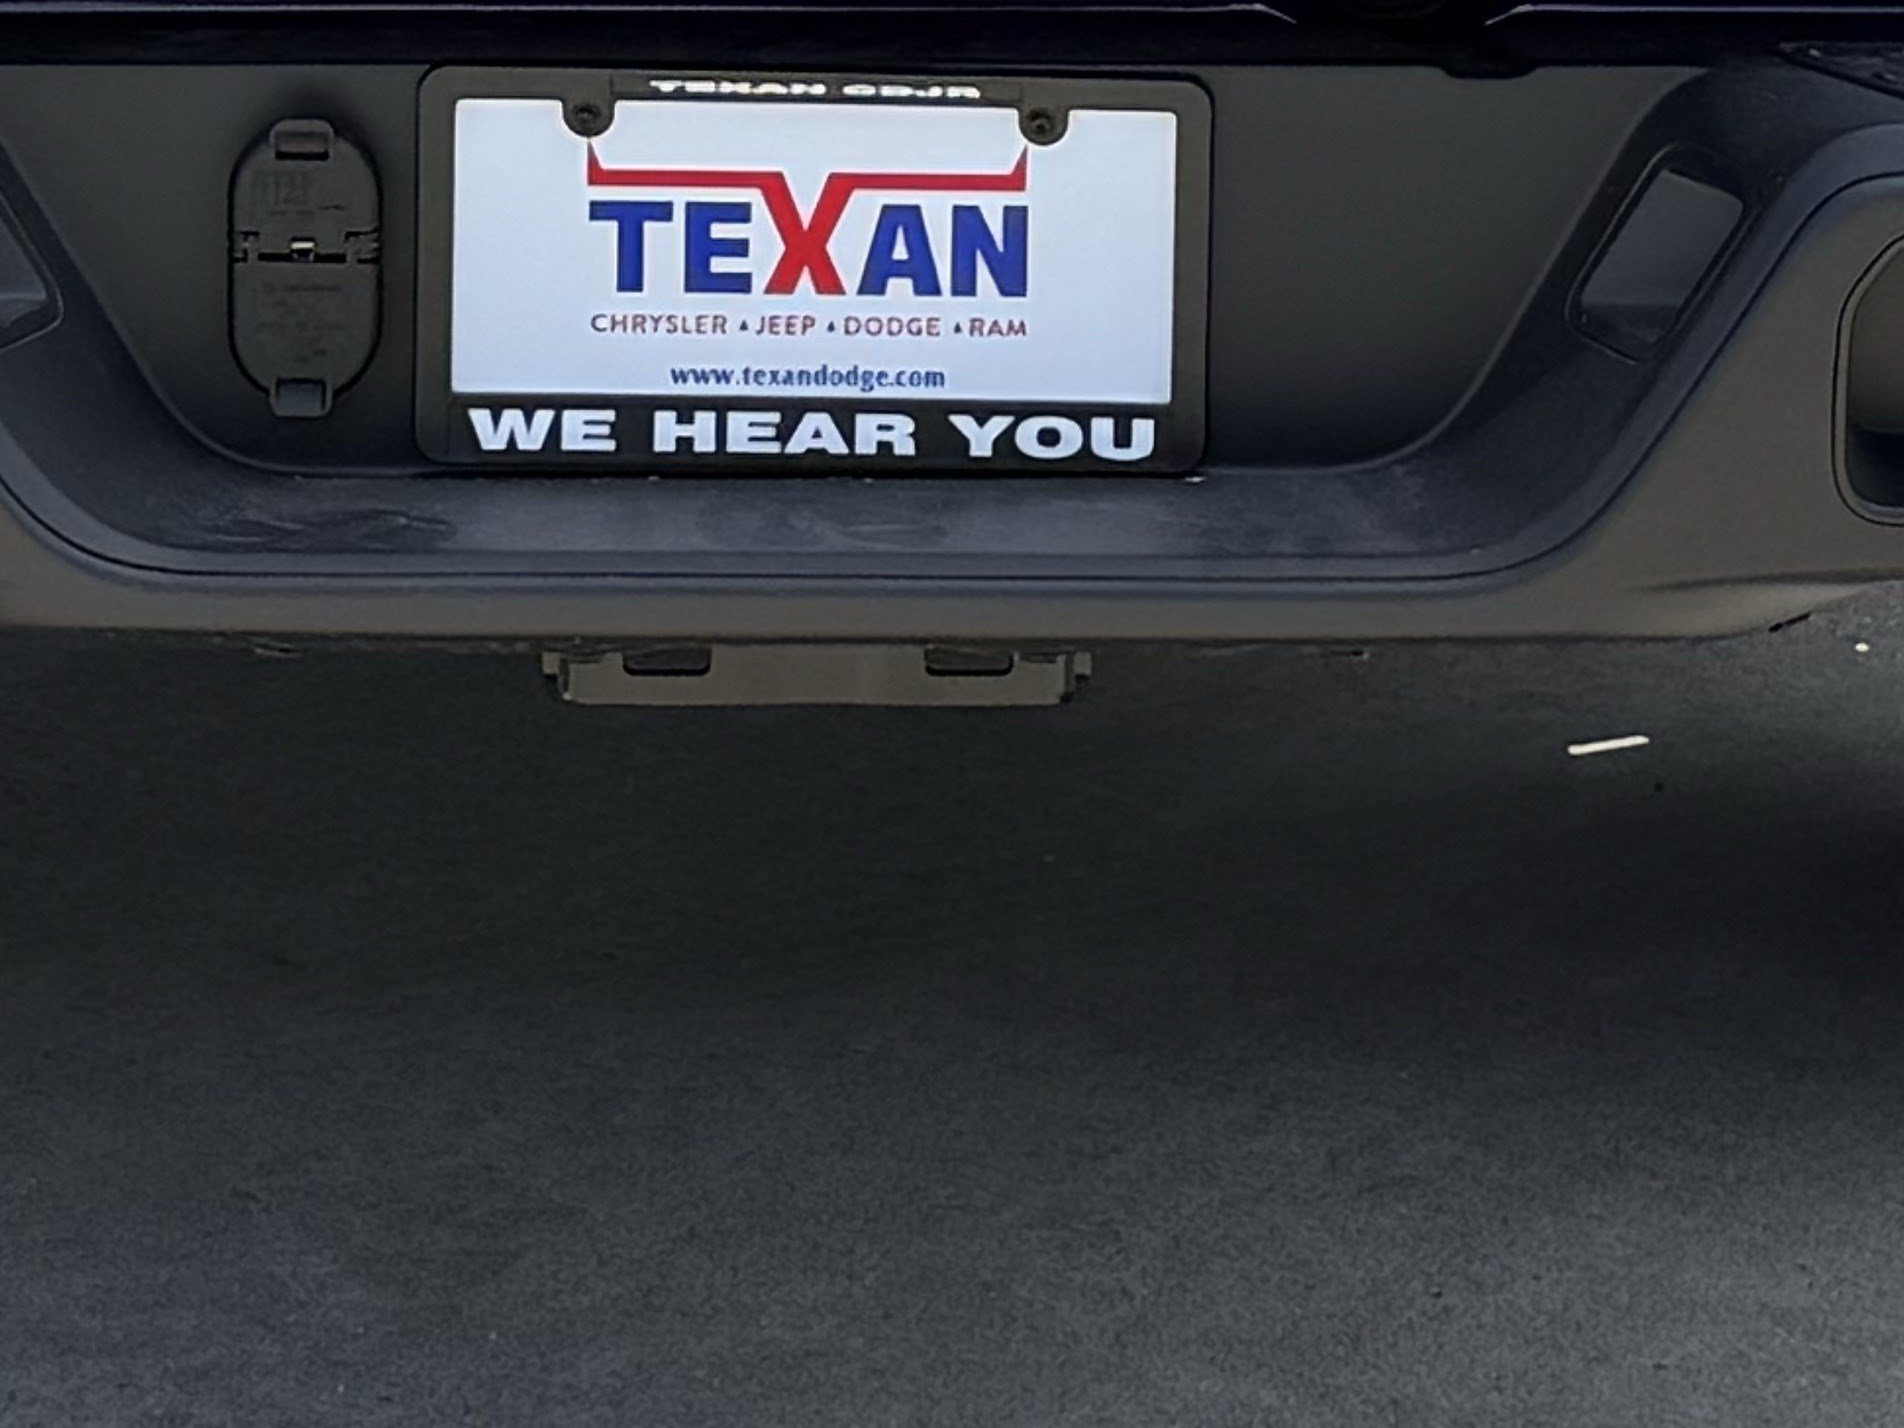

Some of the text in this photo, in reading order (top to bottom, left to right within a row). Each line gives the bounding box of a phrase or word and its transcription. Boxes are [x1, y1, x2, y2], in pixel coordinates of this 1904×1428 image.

[649, 79, 826, 97] TEXAN
[587, 166, 1030, 298] TEXAN
[590, 312, 1029, 339] CHRYSLER JEEP DODGE RAM
[669, 363, 946, 393] www.texandodge.com
[469, 407, 1156, 462] WE HEAR YOU
